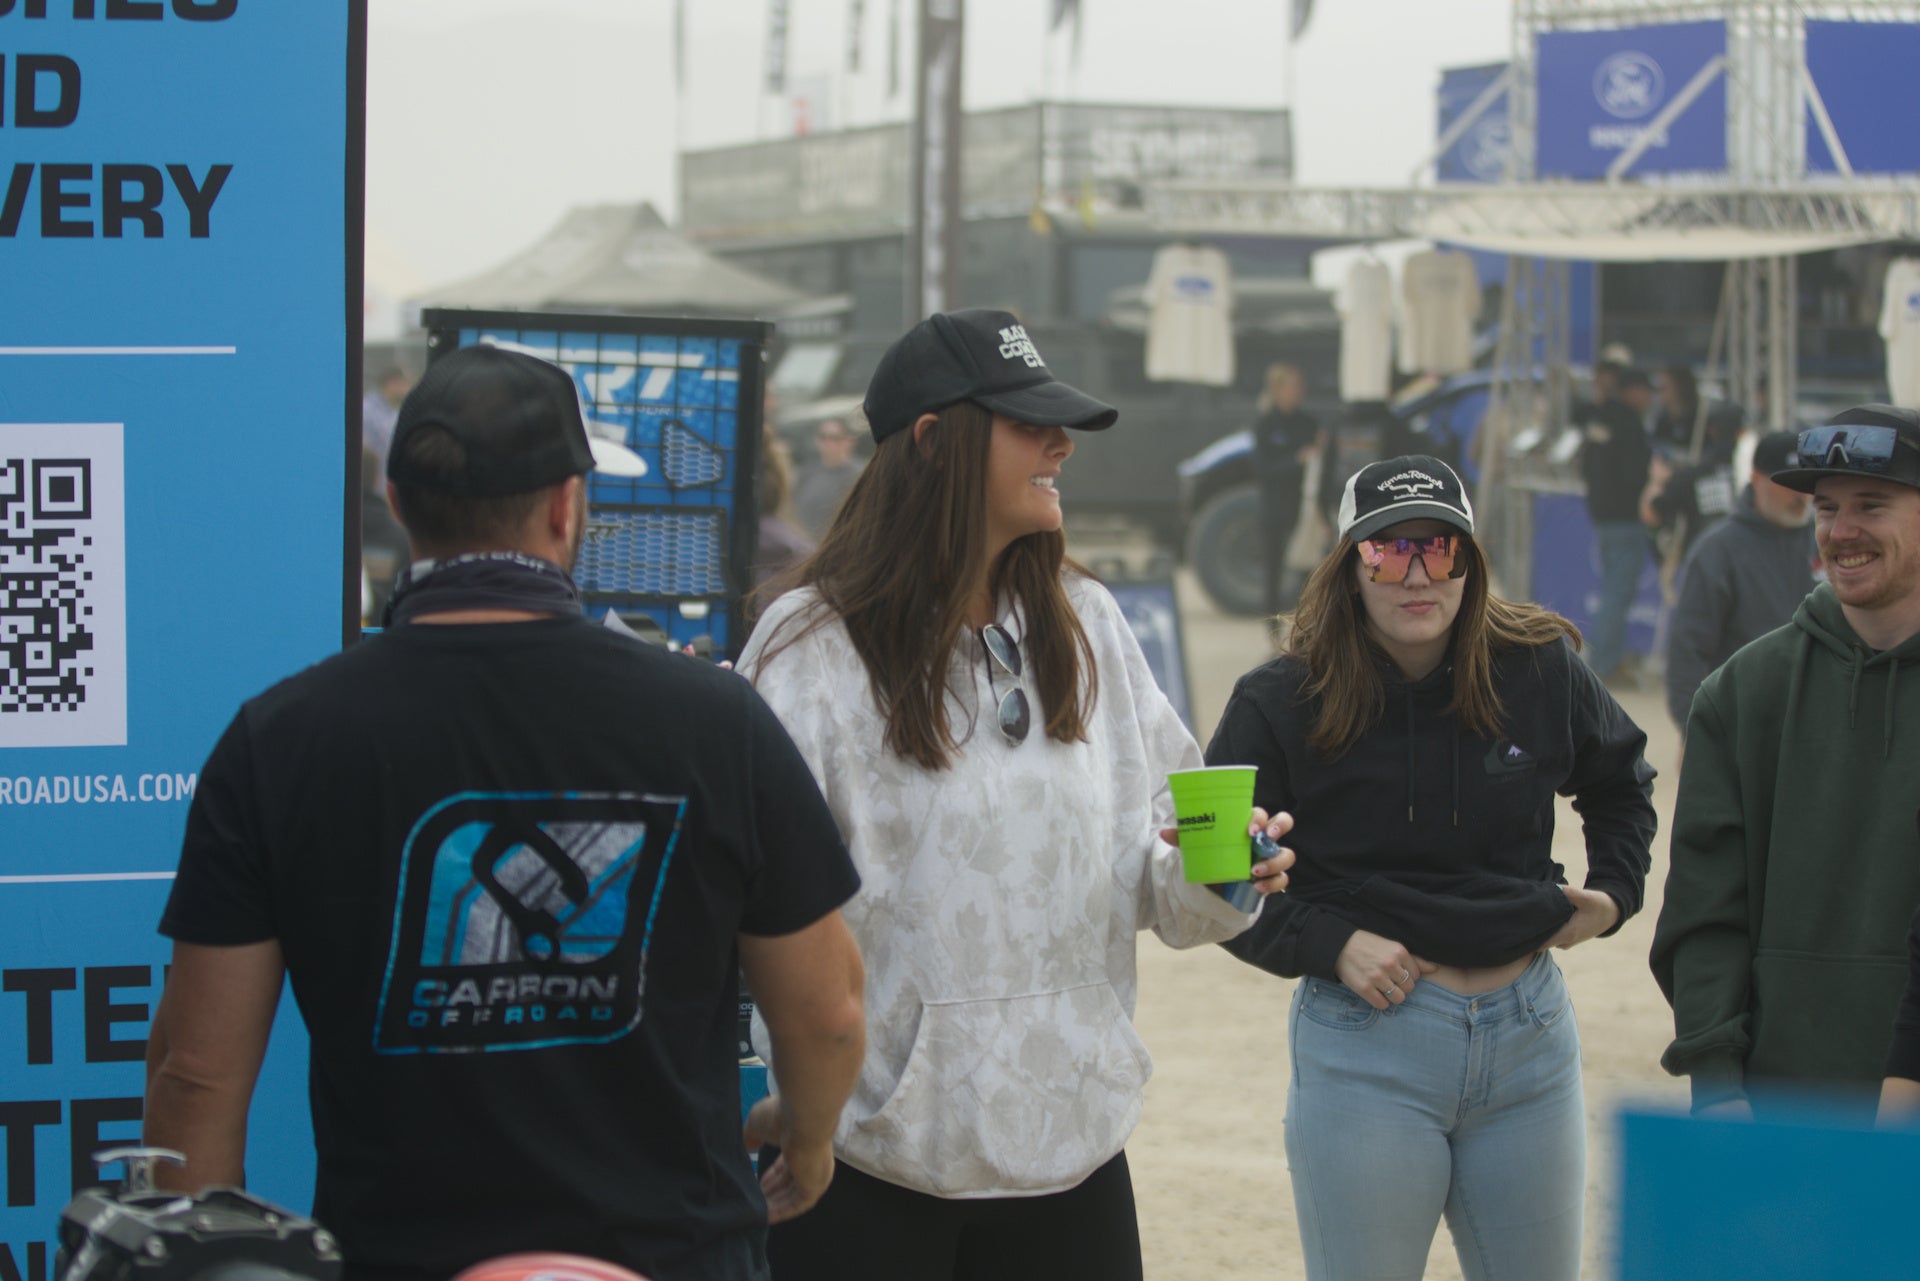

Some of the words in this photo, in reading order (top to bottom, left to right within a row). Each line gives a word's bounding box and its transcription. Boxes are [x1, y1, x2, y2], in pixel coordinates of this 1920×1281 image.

[0, 53, 81, 128] D
[0, 773, 197, 805] ROADUSA.COM
[3, 965, 171, 1065] TE
